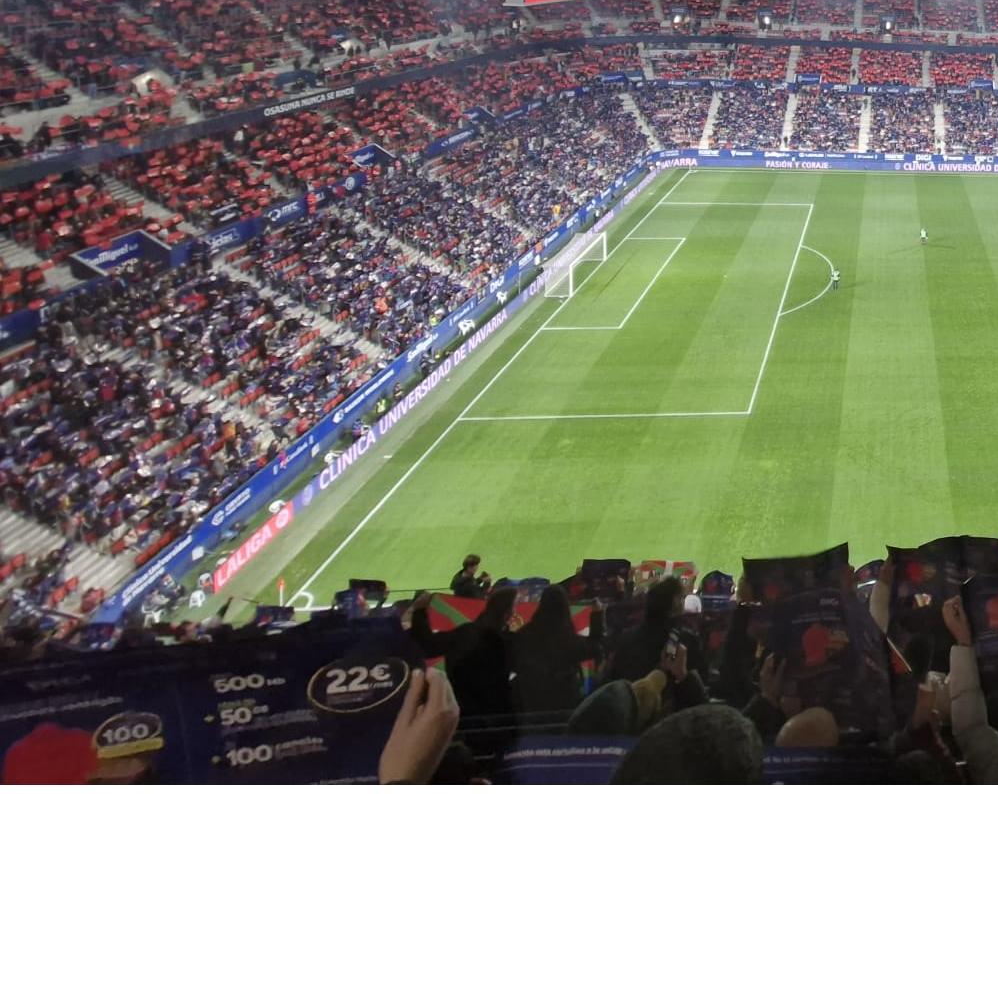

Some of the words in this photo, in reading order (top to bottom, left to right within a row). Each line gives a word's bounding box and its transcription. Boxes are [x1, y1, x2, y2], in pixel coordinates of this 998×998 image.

[264, 100, 300, 116] OSASUNA
[326, 90, 335, 100] SE
[319, 429, 377, 490] CLINICA
[379, 358, 451, 436] UNIVERSIDAD
[453, 347, 467, 366] DE
[468, 309, 508, 347] NAVARRA
[215, 523, 274, 588] LALIGA
[213, 673, 265, 694] 500
[326, 663, 392, 694] 22€
[220, 706, 253, 726] 50
[102, 723, 149, 745] 100
[226, 744, 273, 767] 100
